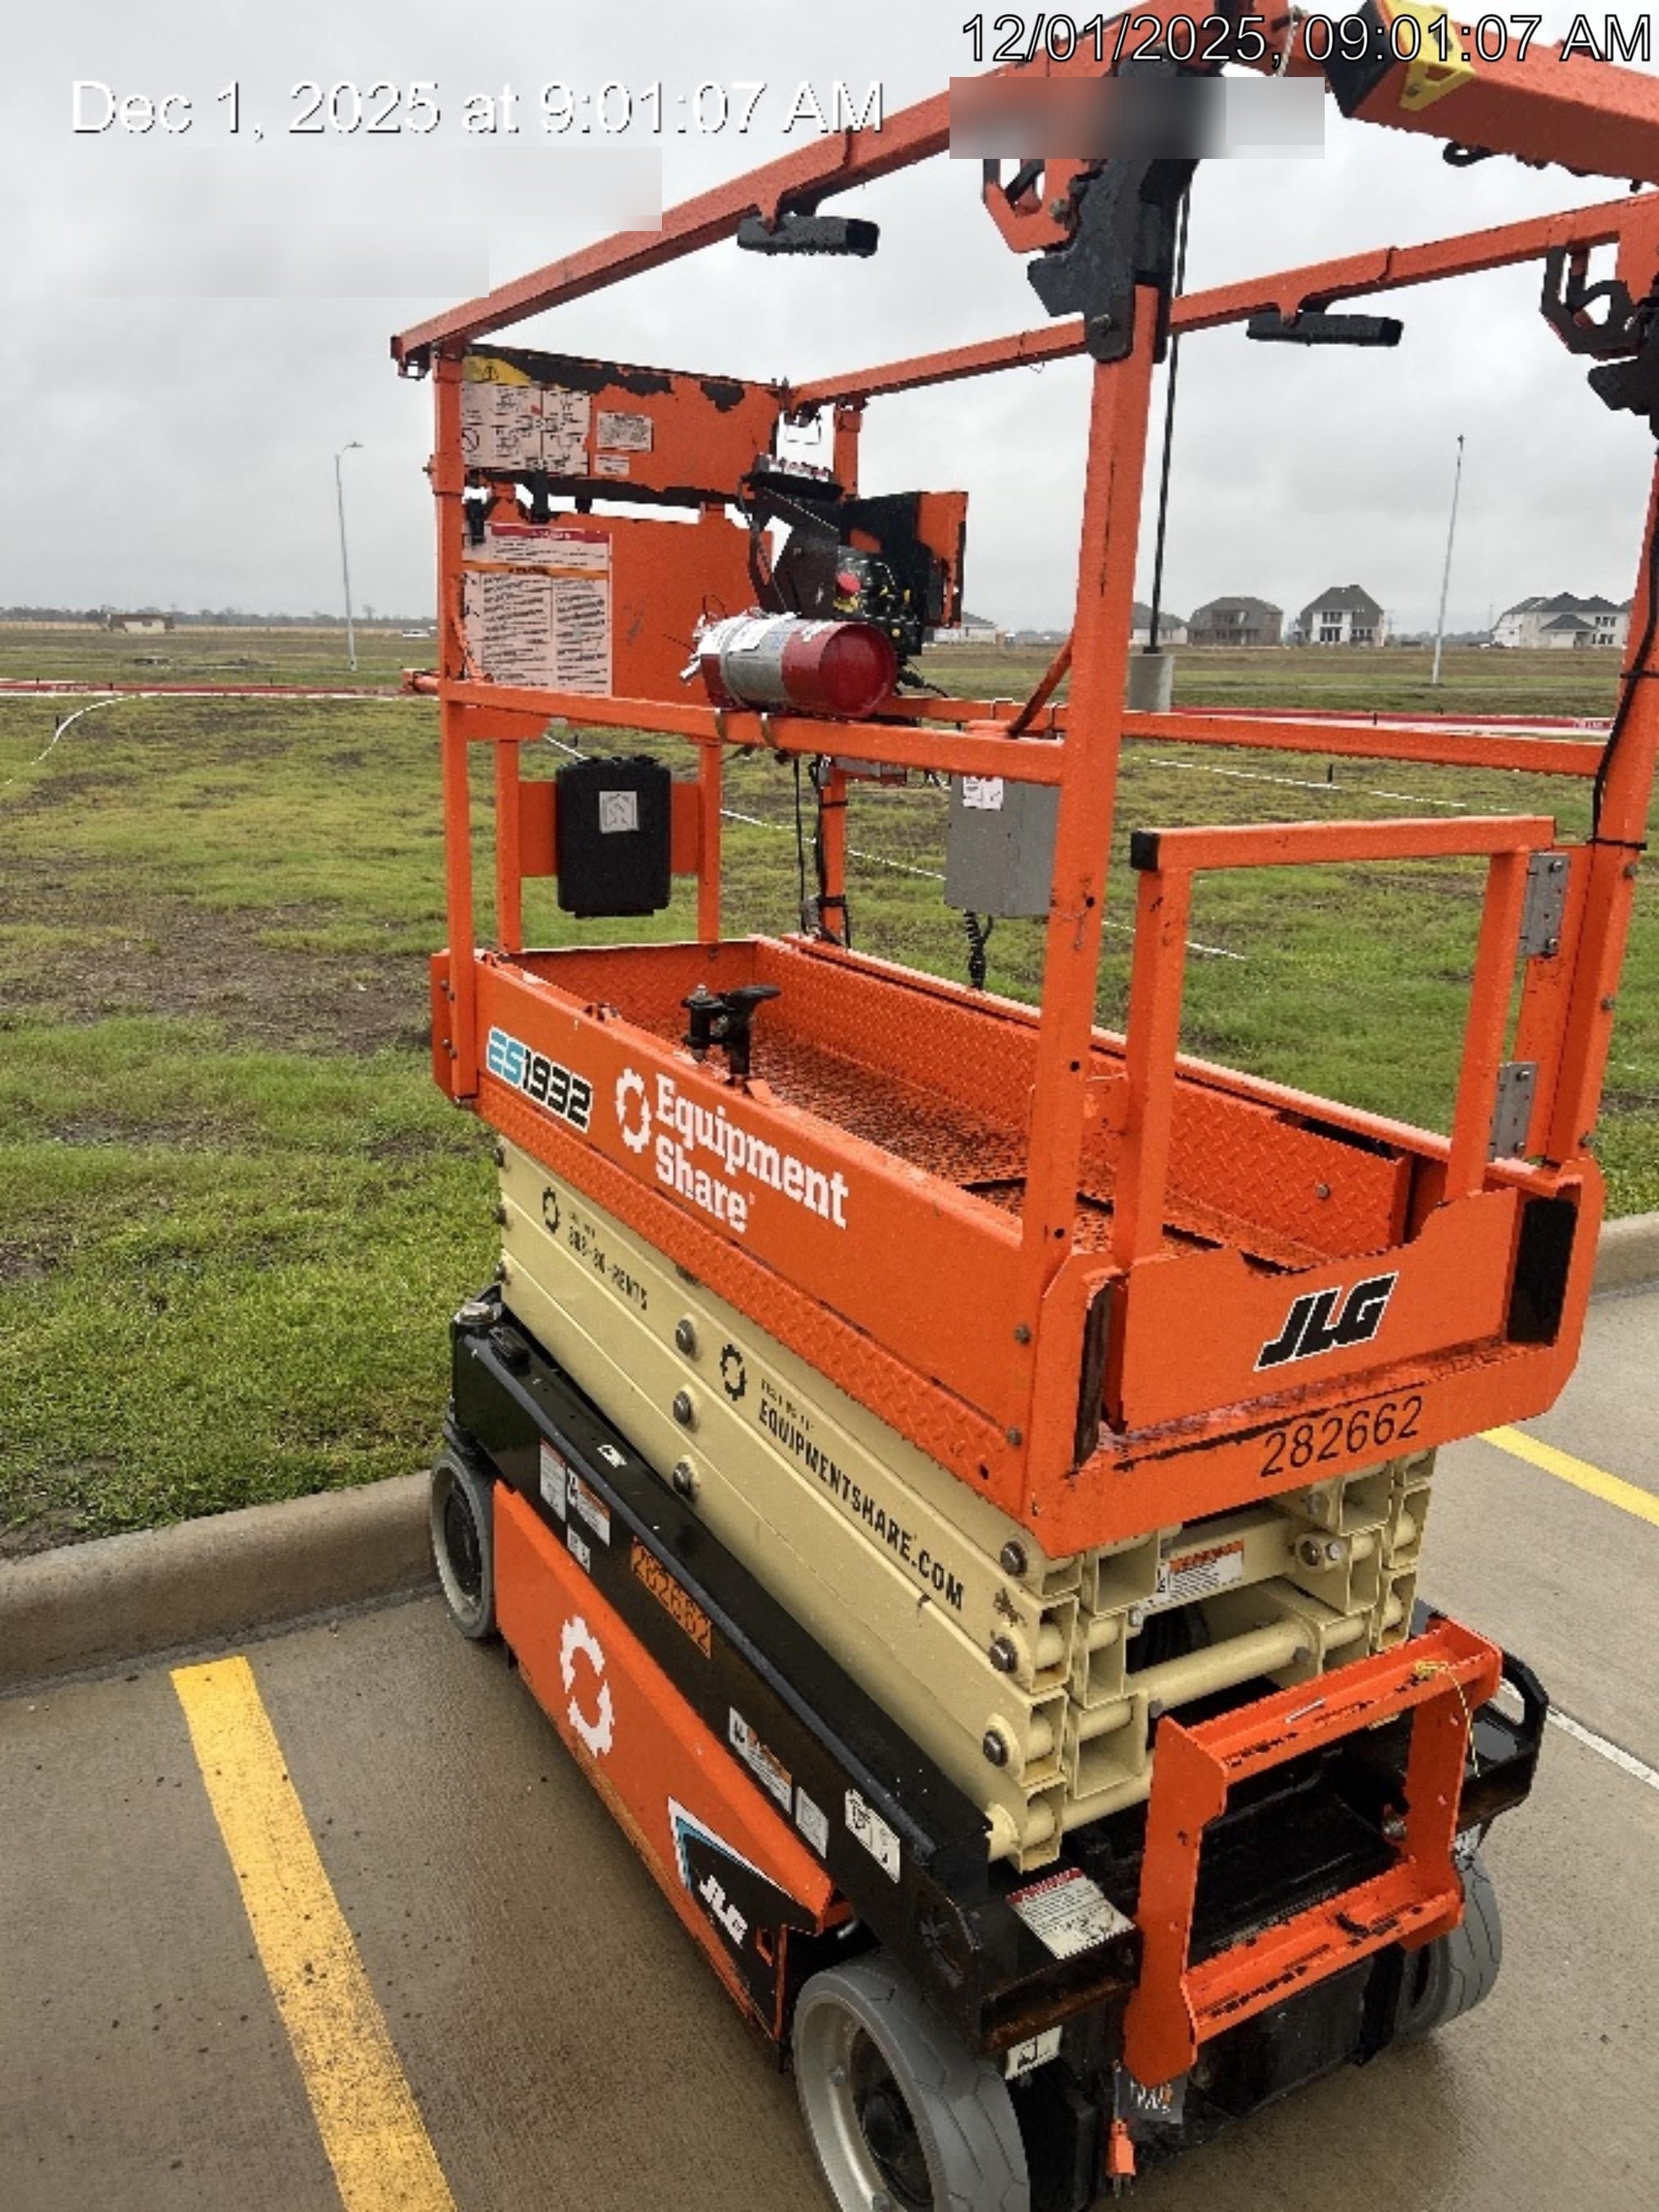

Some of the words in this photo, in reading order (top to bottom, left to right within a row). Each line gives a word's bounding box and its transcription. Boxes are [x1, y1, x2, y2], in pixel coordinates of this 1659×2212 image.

[488, 1029, 592, 1131] ES1932
[655, 1072, 850, 1229] Equipment
[655, 1133, 748, 1234] Share
[1253, 1271, 1399, 1372] JLG
[1260, 1395, 1423, 1478] 282662
[759, 1398, 965, 1611] EQUIPMENTSHARE.COM
